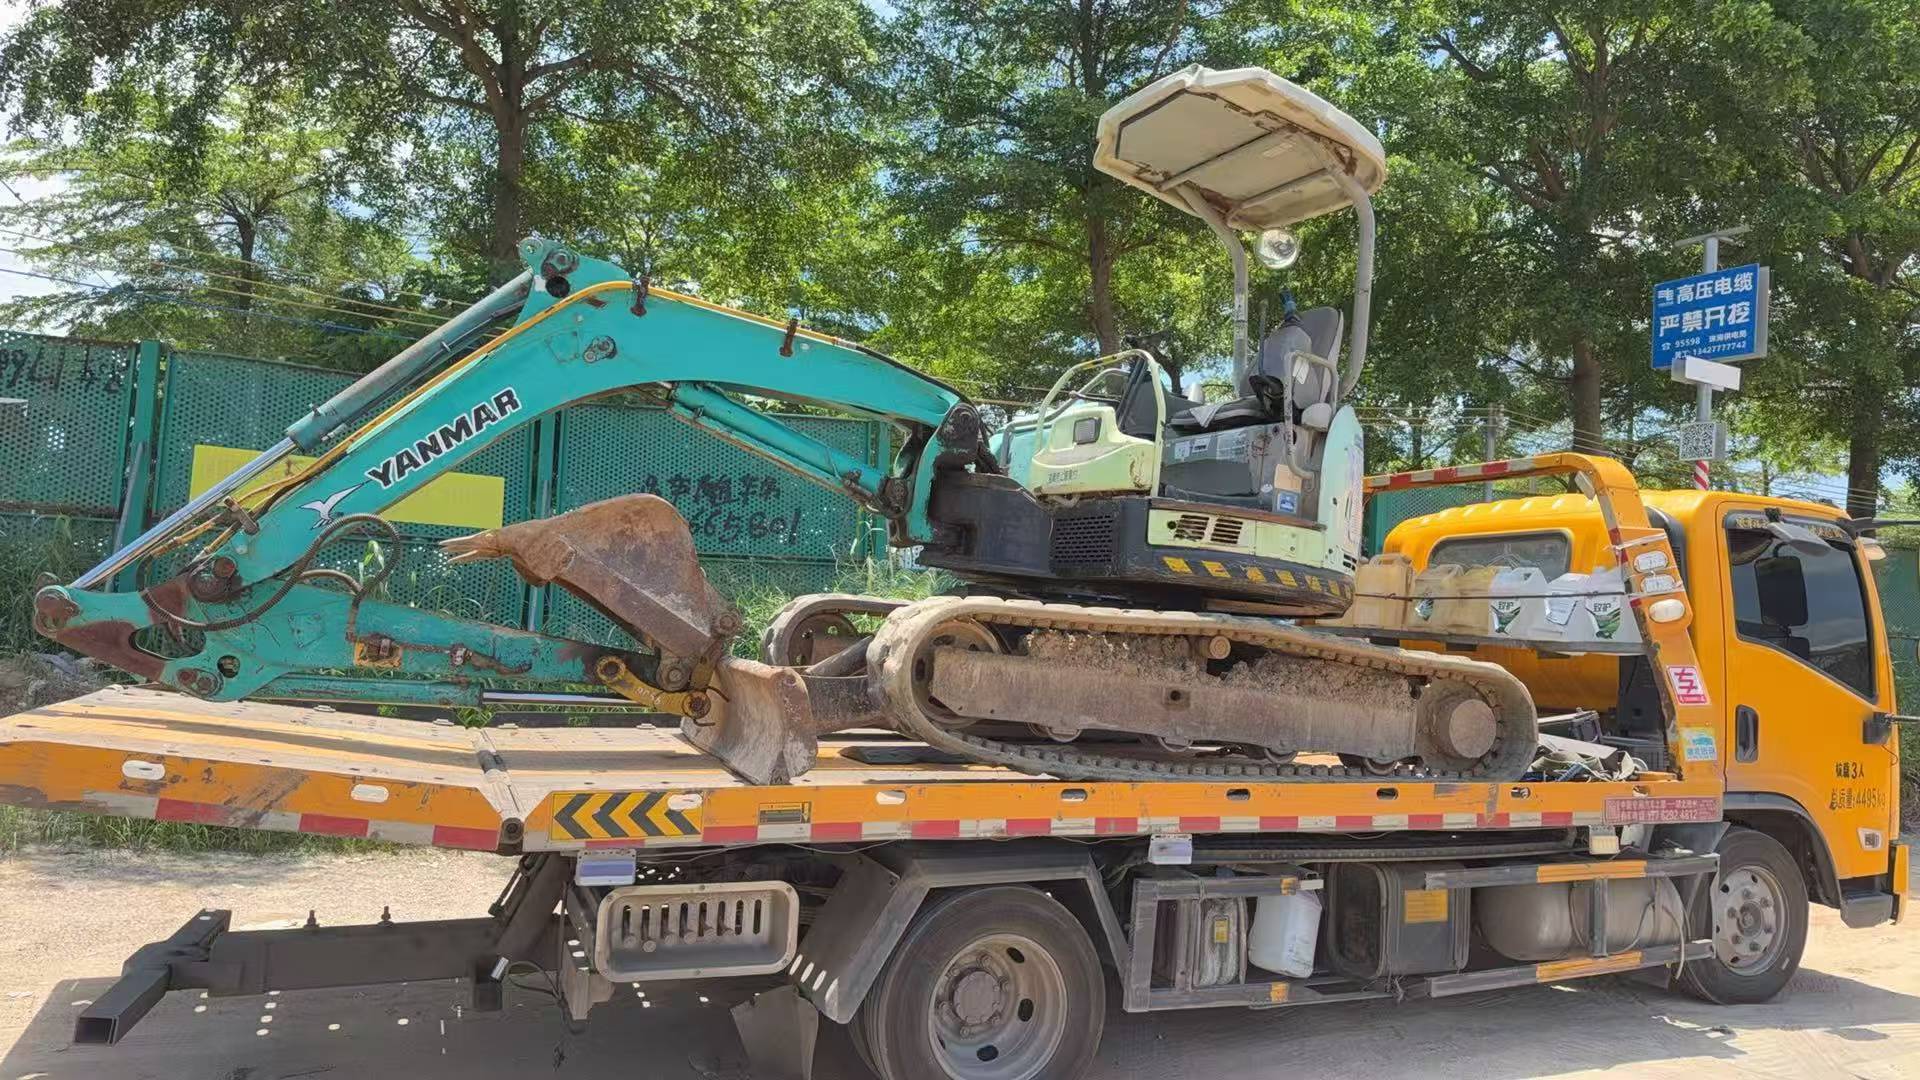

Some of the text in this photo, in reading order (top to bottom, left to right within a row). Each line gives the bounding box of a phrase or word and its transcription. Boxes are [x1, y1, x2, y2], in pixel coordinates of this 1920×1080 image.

[1677, 272, 1753, 304] 高压电缆
[1659, 301, 1750, 337] 严禁开挖
[1674, 337, 1701, 348] 95598
[366, 387, 521, 489] YANMAR
